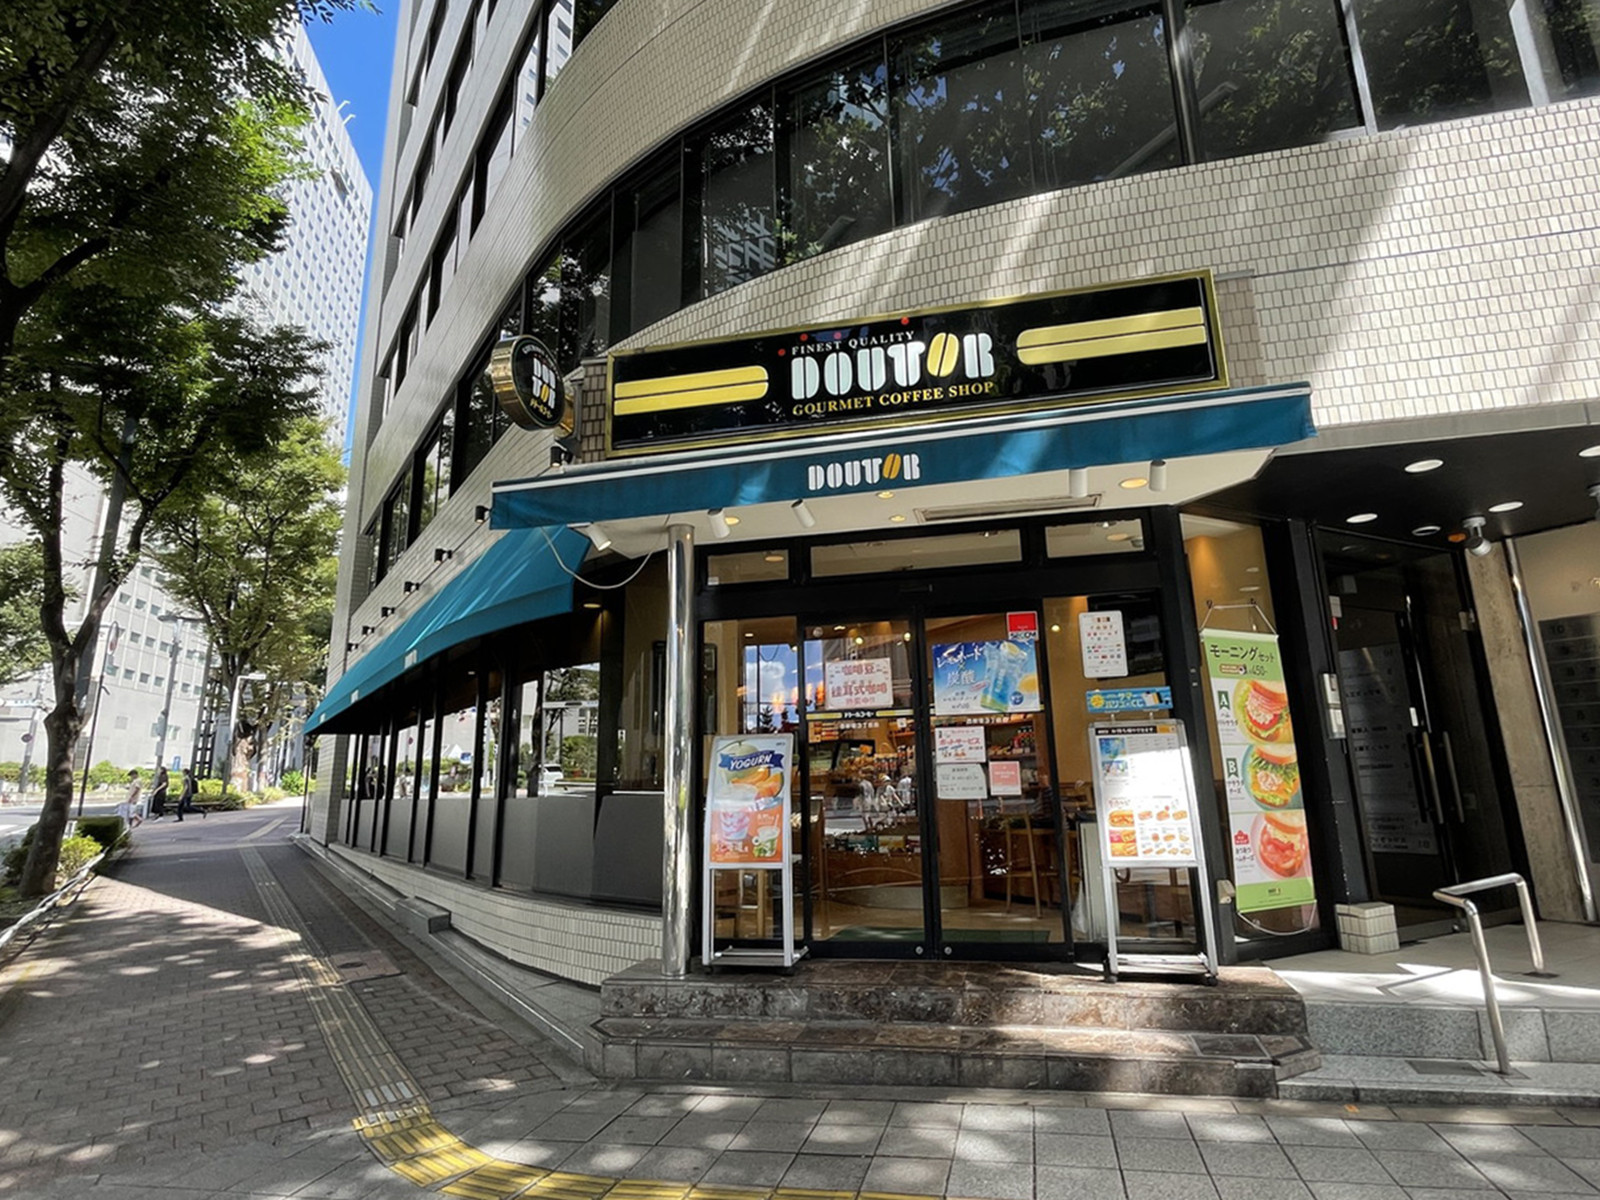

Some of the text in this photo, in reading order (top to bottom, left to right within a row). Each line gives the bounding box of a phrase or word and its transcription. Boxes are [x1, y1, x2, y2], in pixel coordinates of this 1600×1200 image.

[791, 330, 915, 355] FINEST QUALITY
[791, 331, 995, 400] DOUTOR
[792, 381, 995, 416] GOURMET COFFEE SHOP
[808, 453, 921, 491] DOUTOR
[730, 753, 773, 770] YOGURN
